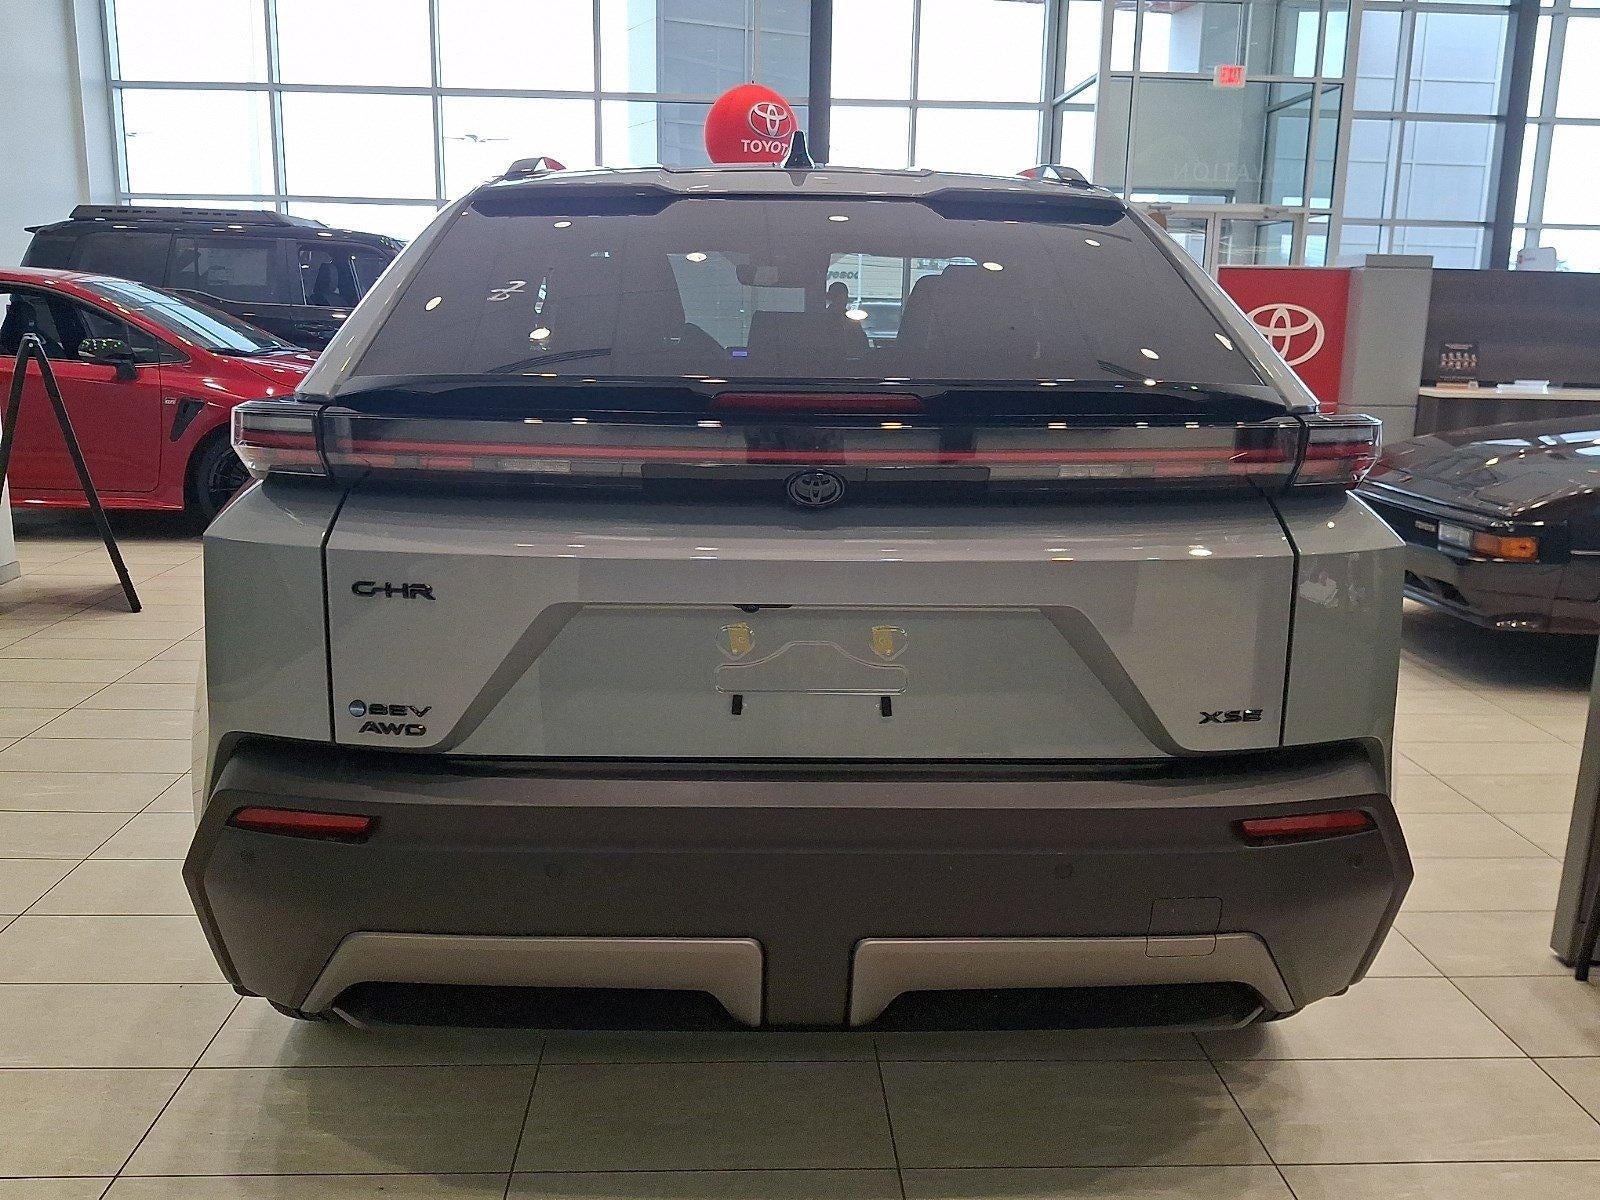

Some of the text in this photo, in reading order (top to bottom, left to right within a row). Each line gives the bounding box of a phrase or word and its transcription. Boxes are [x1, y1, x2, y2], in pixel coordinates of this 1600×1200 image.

[351, 581, 437, 601] C-HR
[368, 703, 432, 718] BEV
[1198, 709, 1264, 725] XSE
[358, 721, 427, 736] AWD
